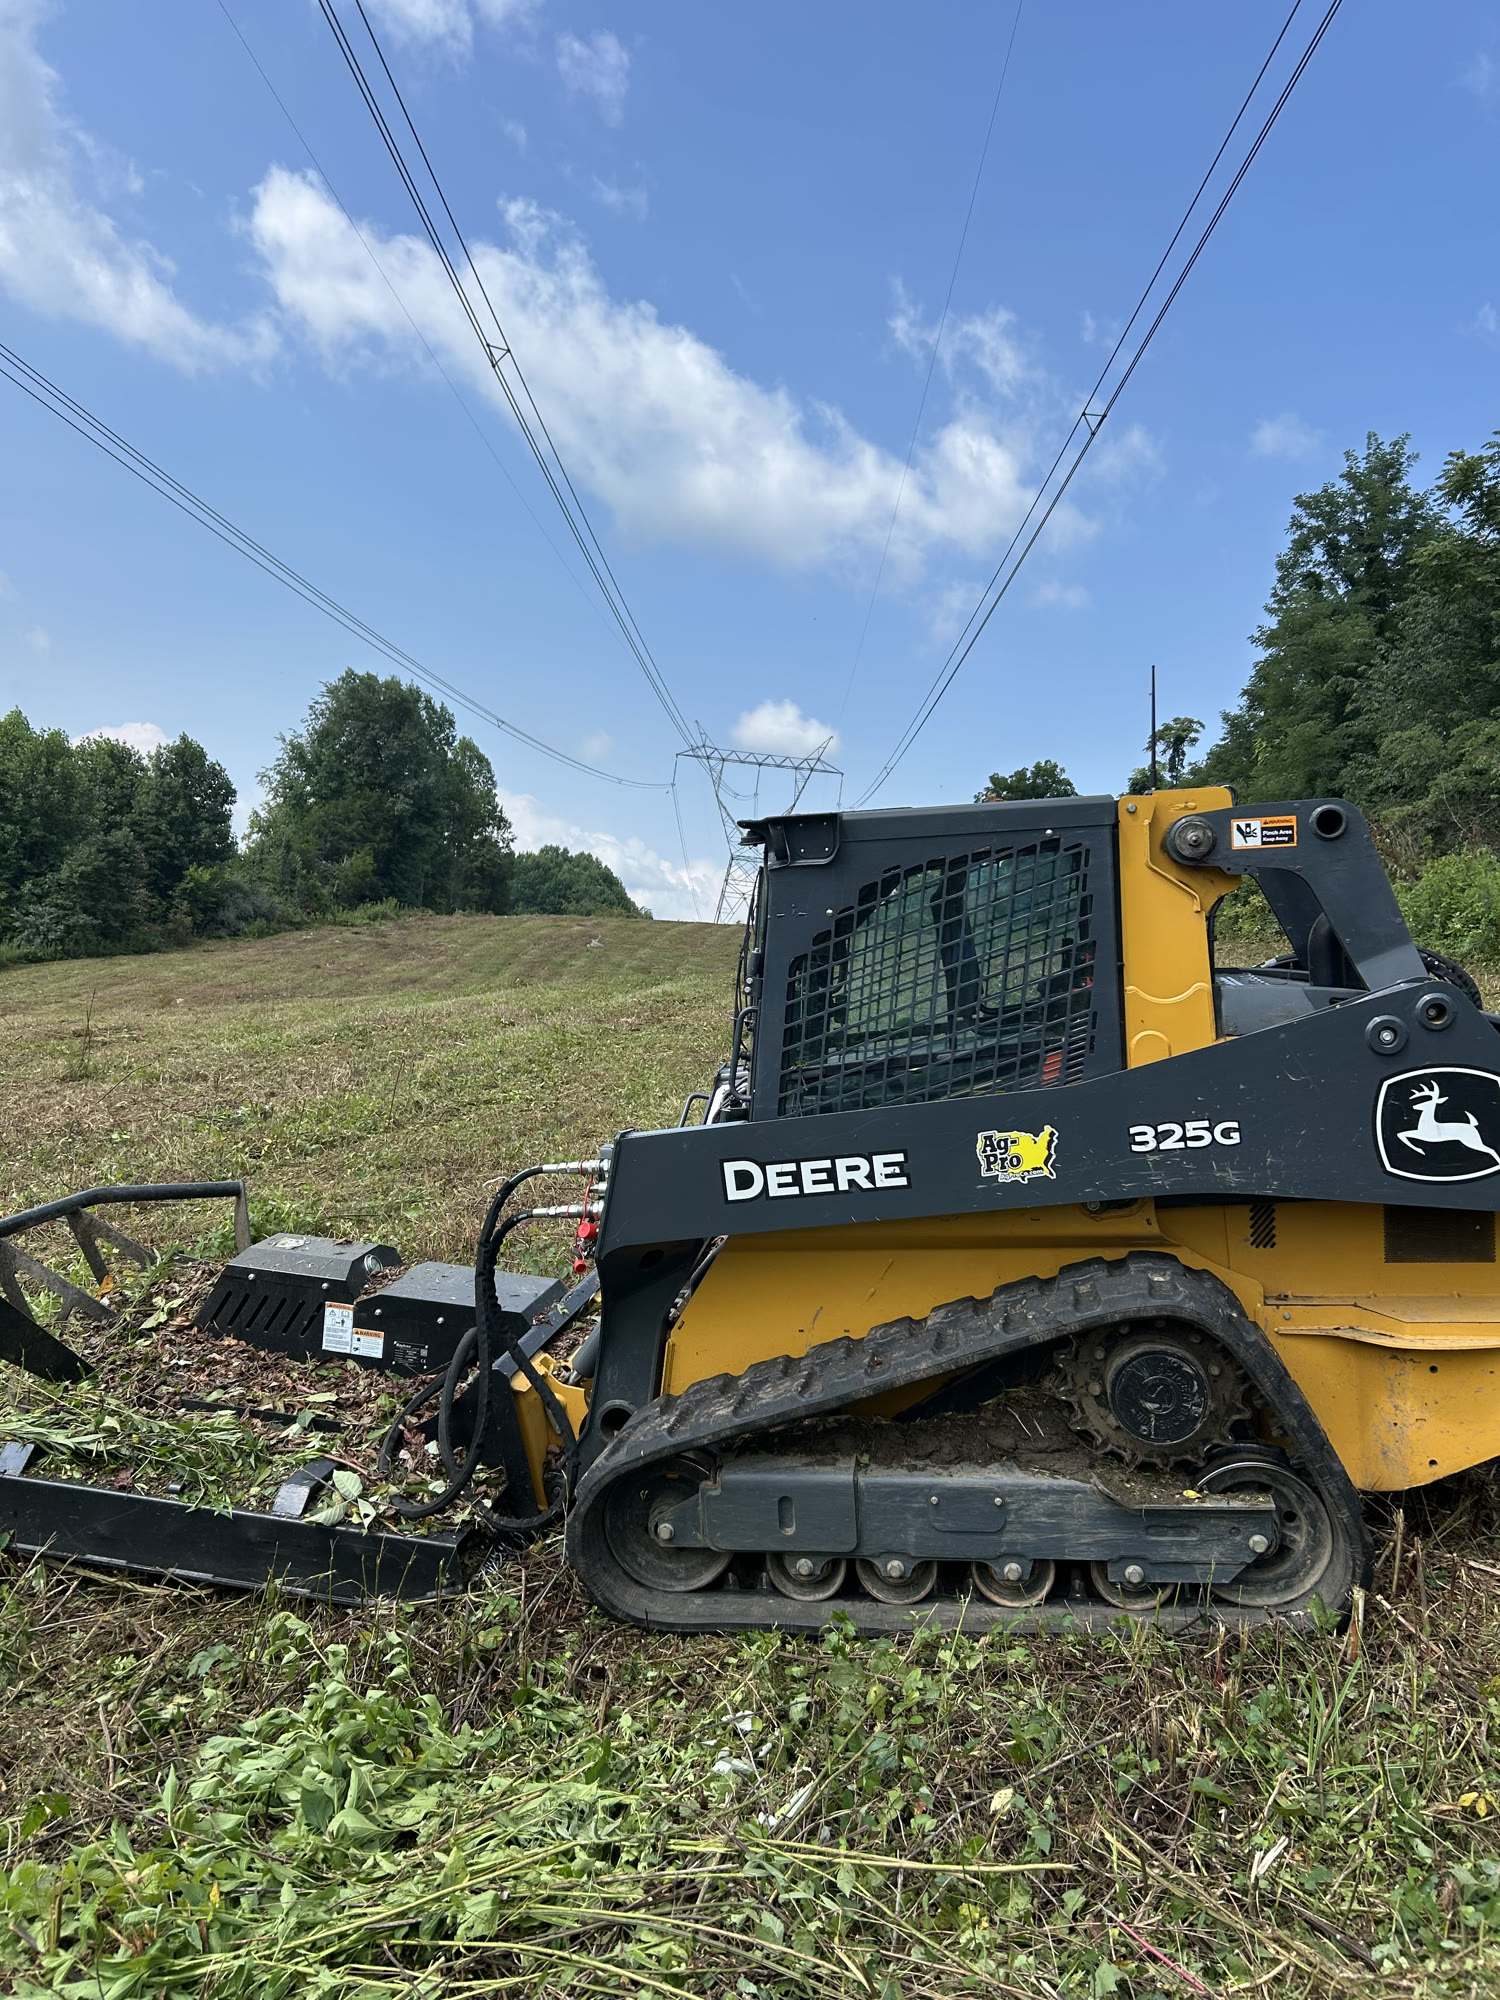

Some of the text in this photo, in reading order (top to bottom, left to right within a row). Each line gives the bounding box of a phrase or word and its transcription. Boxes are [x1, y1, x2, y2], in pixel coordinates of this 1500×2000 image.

[981, 1134, 1018, 1156] Ag-
[1129, 1120, 1241, 1152] 325G
[983, 1153, 1022, 1173] Pro
[723, 1152, 908, 1201] DEERE
[360, 1330, 381, 1338] WARNING
